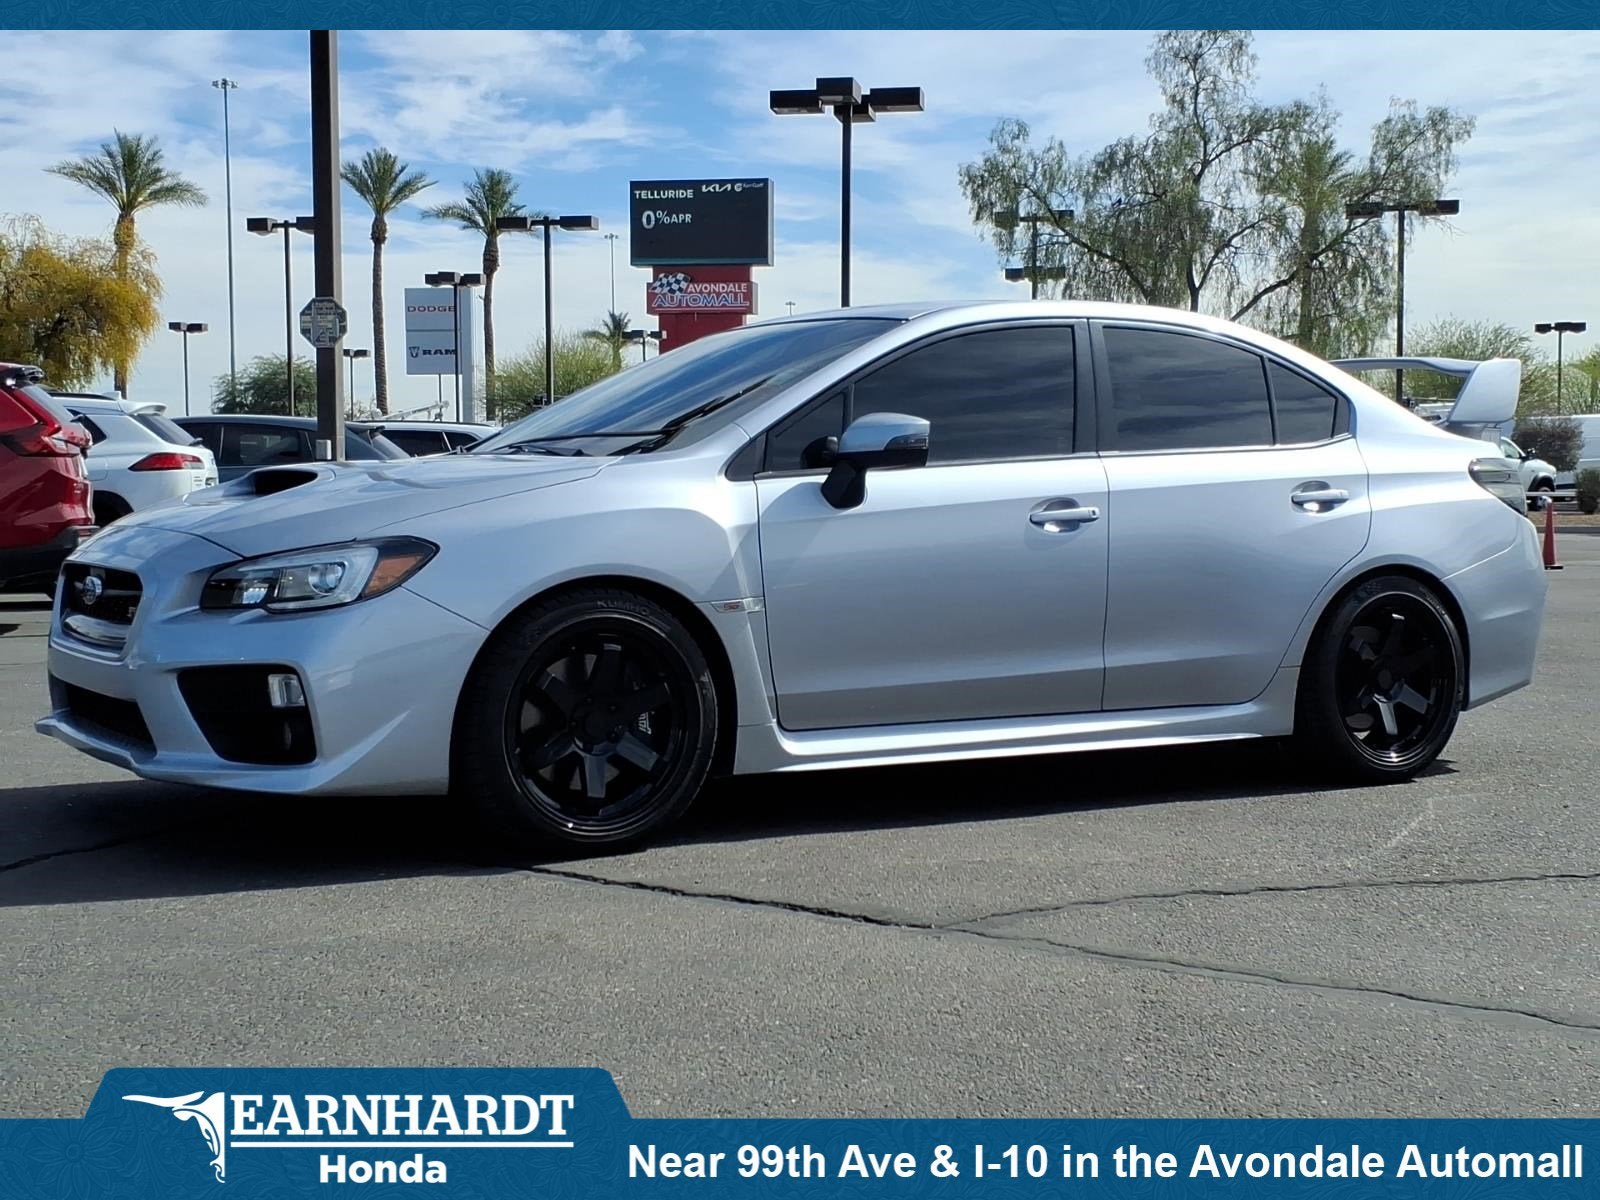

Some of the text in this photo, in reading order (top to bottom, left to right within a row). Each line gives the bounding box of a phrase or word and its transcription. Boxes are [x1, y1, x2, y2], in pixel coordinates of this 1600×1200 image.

[702, 183, 731, 193] KIA
[634, 189, 694, 199] TELLURIDE
[687, 283, 748, 293] AVONDALE
[652, 294, 749, 307] AUTOMALL
[407, 305, 456, 313] DODGE
